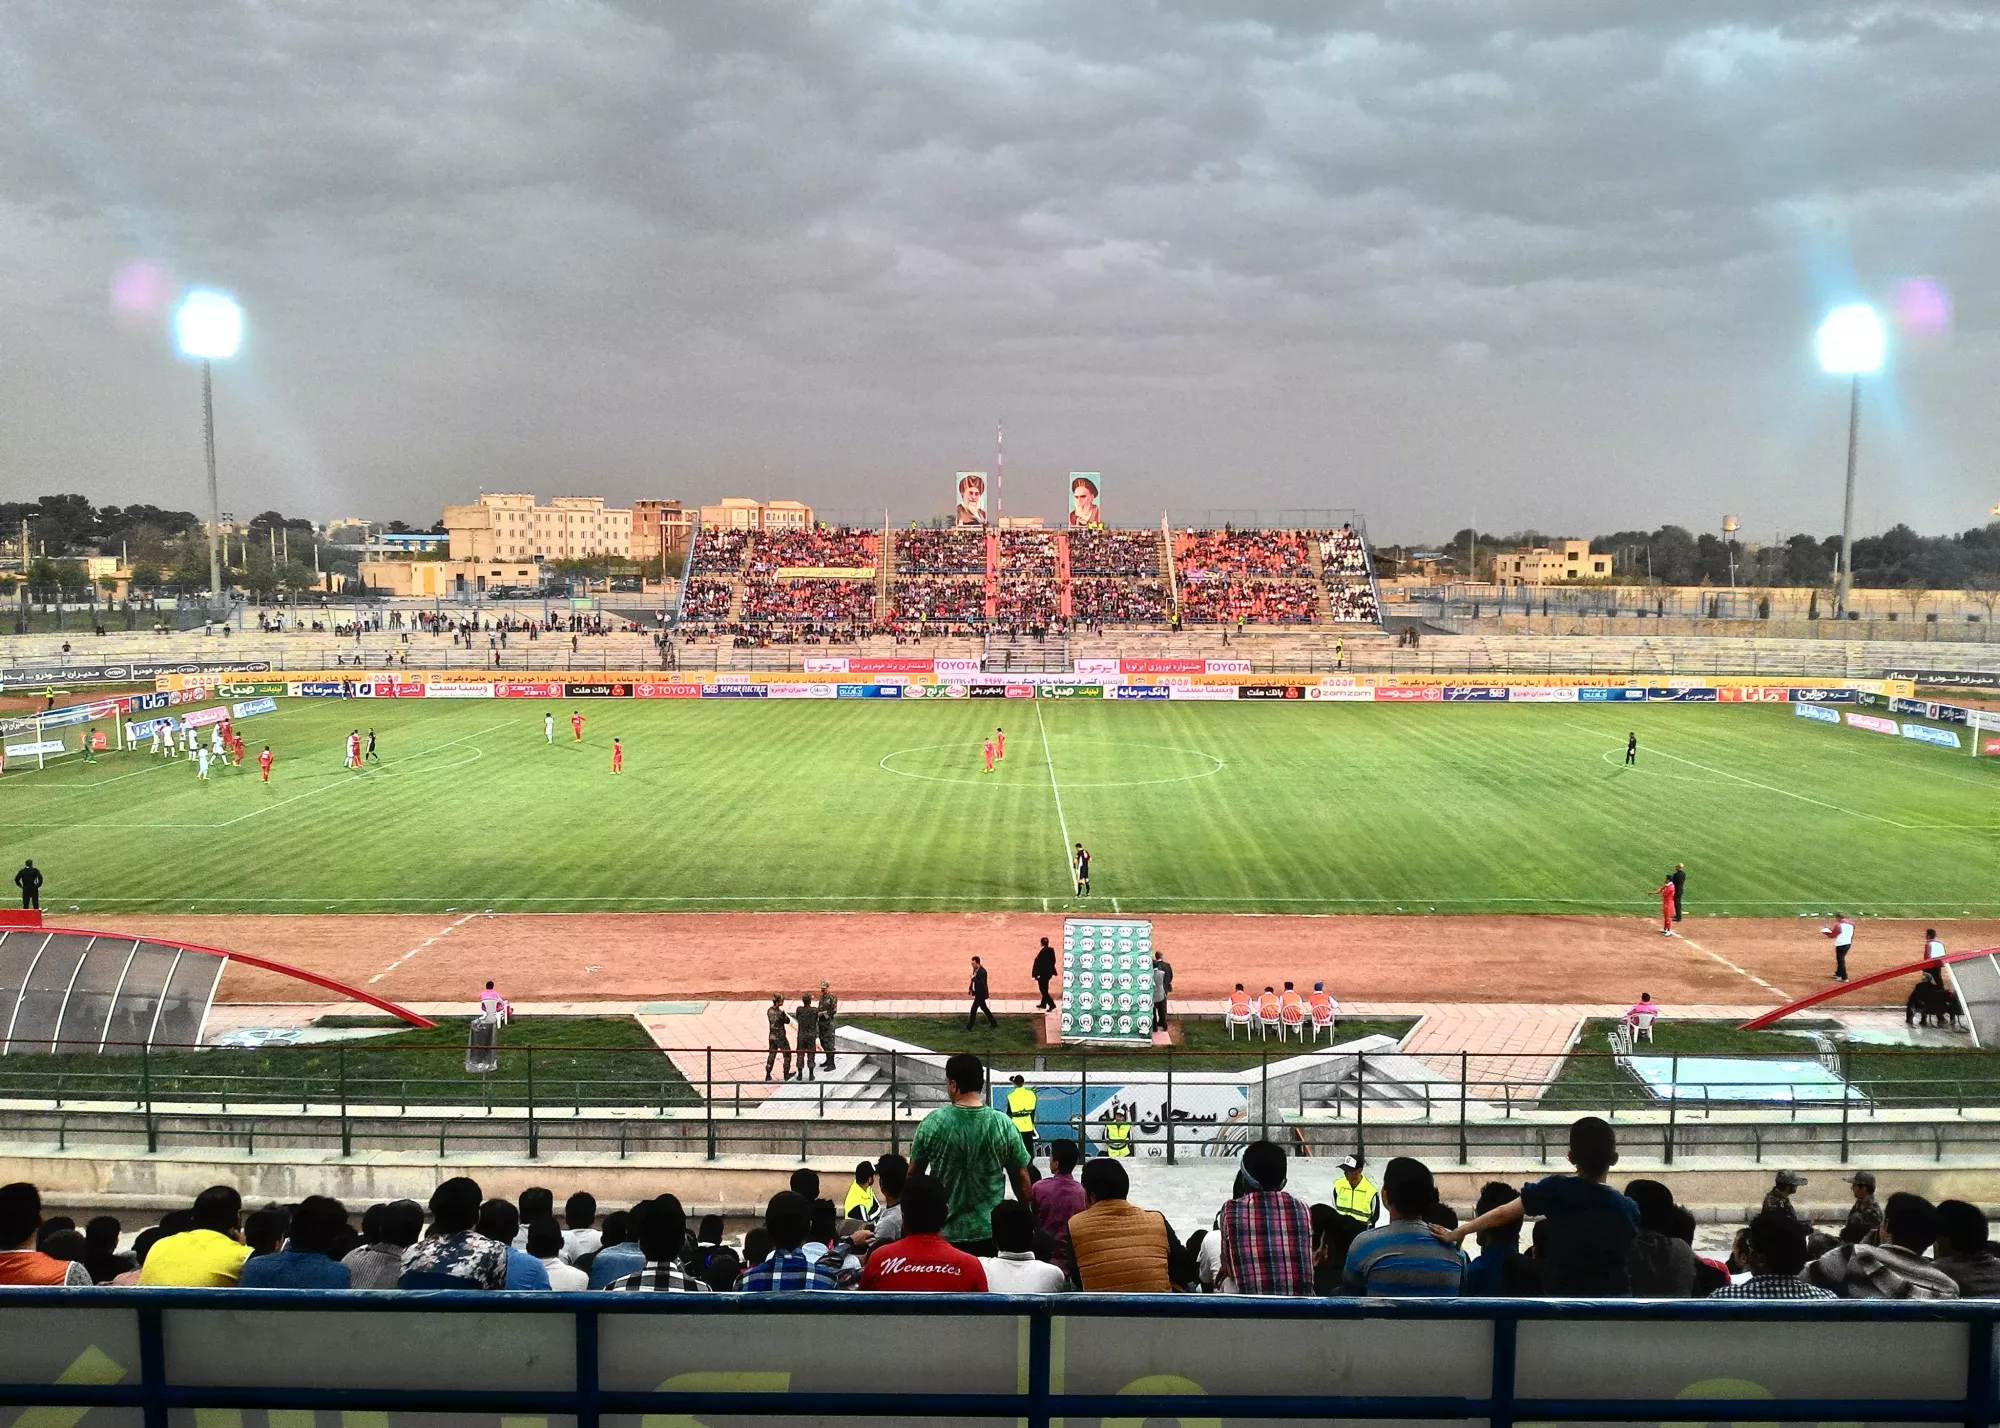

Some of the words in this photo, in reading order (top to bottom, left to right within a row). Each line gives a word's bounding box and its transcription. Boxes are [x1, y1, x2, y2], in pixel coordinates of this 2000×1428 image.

[154, 667, 177, 675] مدیران
[203, 664, 223, 673] خودرو
[223, 663, 246, 672] مدیران
[886, 661, 898, 671] برند
[899, 660, 934, 672] ارزشمندترین
[935, 661, 979, 671] TOYOTA
[1147, 662, 1172, 673] نوروزی
[1172, 662, 1202, 672] جشنواره
[1206, 662, 1250, 672] TOYOTA
[34, 671, 66, 681] خودرو
[67, 670, 100, 681] مدیران
[133, 667, 154, 676] خودرو
[567, 676, 585, 684] ارسال
[1928, 675, 1960, 683] خودرو
[1961, 675, 1994, 685] مدیران
[217, 684, 256, 697] صباح
[303, 684, 333, 696] سرمایه
[572, 686, 592, 694] ملت
[591, 686, 611, 696] بانک
[657, 686, 697, 695] TOYOTA
[720, 685, 743, 697] SEPEHR
[741, 685, 768, 697] ELECTRIC
[788, 686, 808, 694] مدیران
[1041, 685, 1075, 699] صباح
[1078, 687, 1099, 695] لبنیات
[1118, 686, 1148, 698] سرمایه
[1148, 686, 1169, 698] بانک
[1246, 688, 1265, 697] ملت
[1265, 688, 1284, 698] بانک
[1797, 688, 1828, 701] میهن
[1858, 691, 1876, 707] صباح
[1140, 1101, 1217, 1135] سبحان
[880, 1257, 962, 1276] Memories
